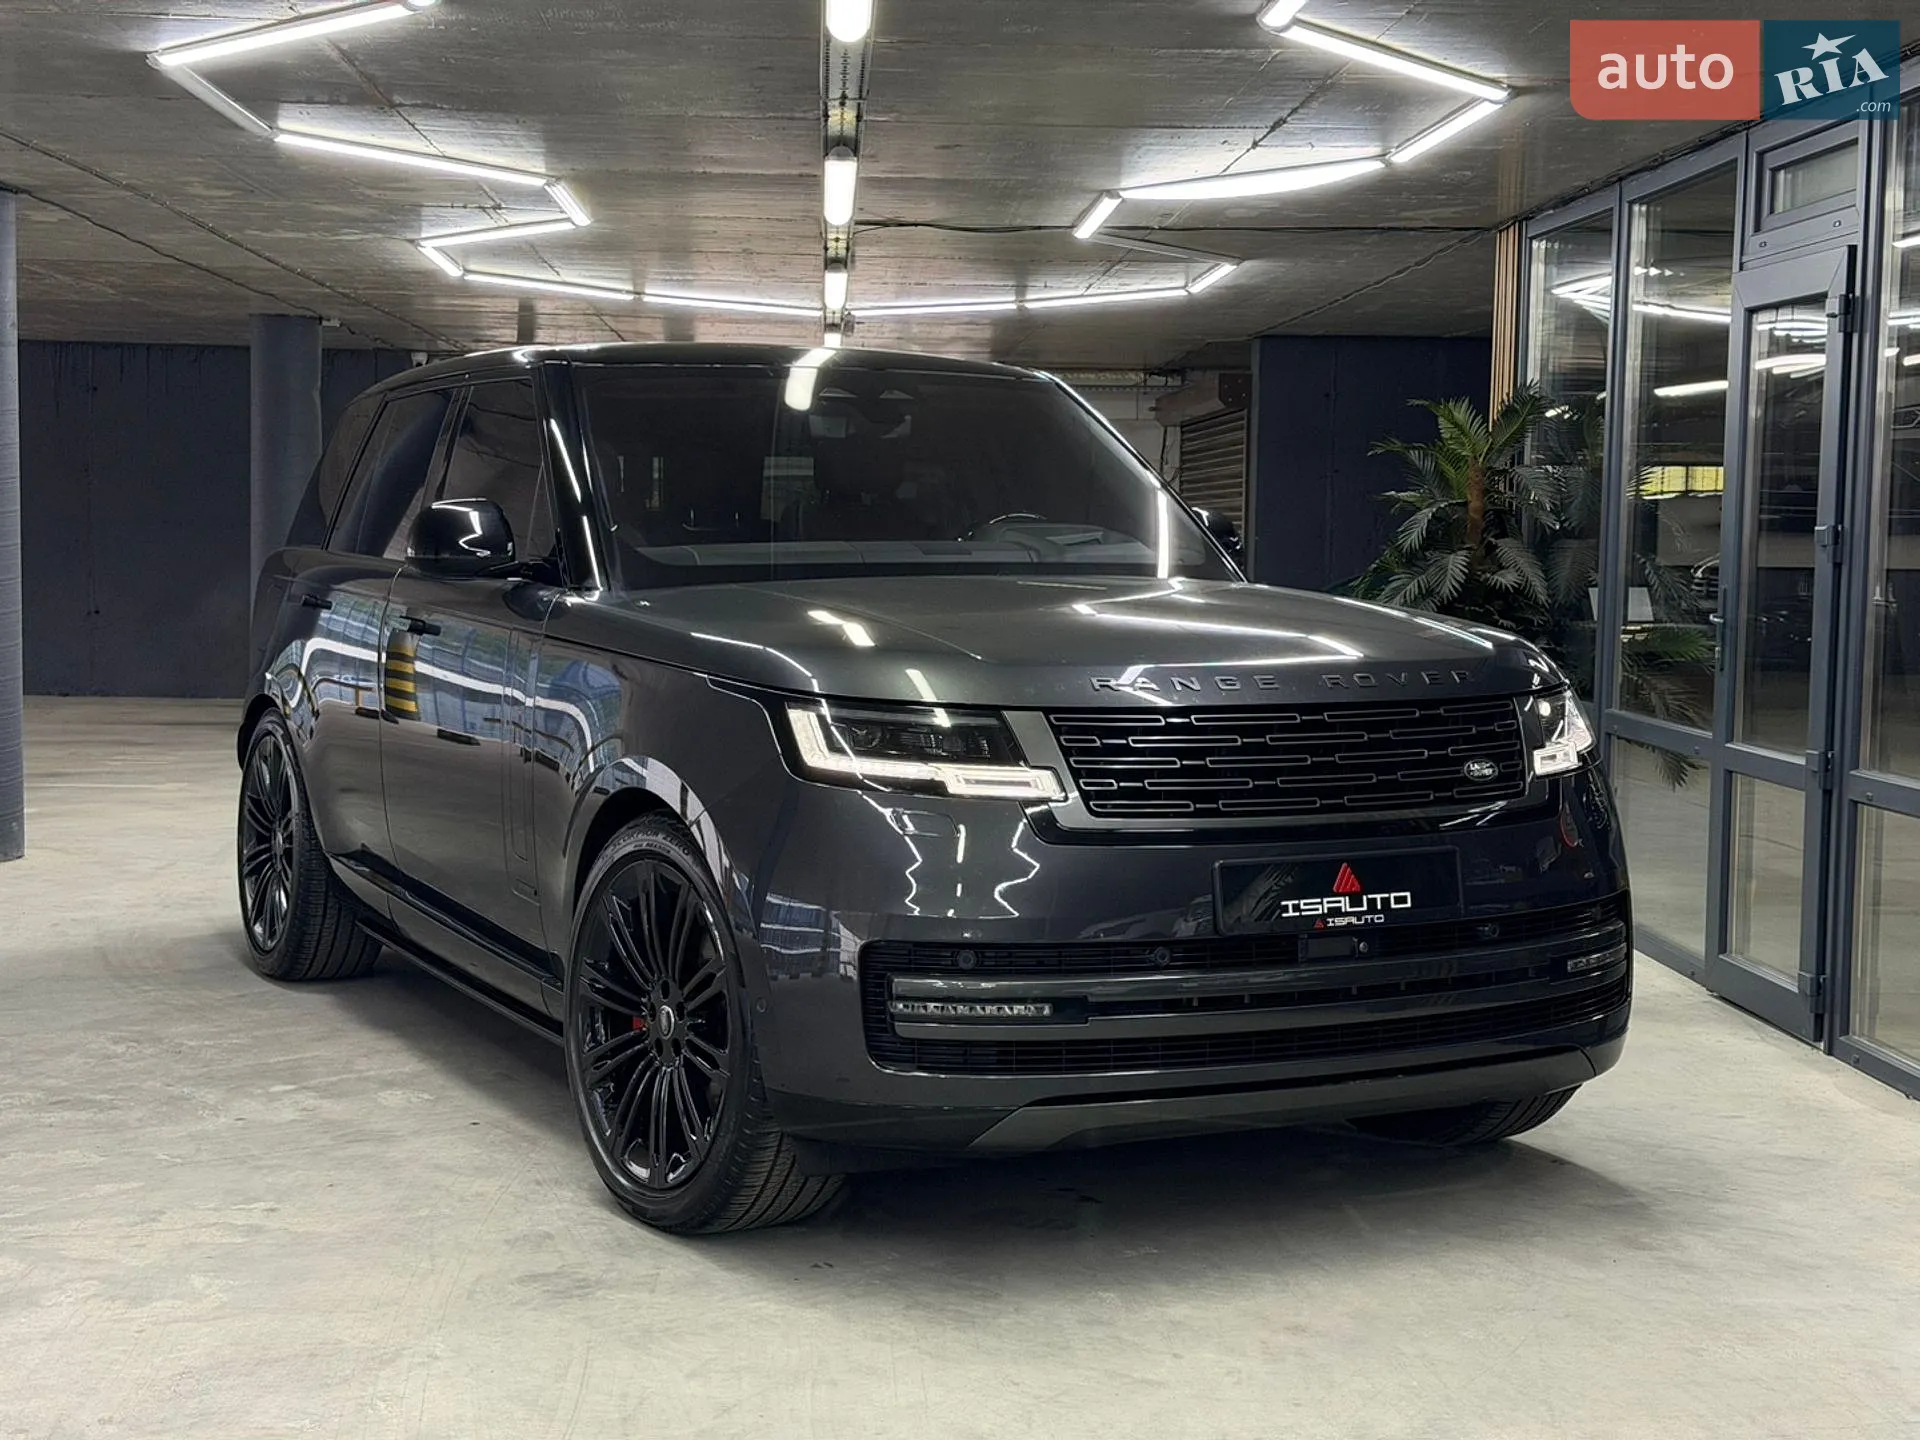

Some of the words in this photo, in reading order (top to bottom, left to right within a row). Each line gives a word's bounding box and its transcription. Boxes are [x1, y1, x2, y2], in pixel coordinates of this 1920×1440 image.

[1089, 674, 1281, 692] RANGE
[1320, 669, 1476, 690] ROVER
[1280, 891, 1412, 918] ISAUTO
[1326, 914, 1385, 928] ISAUTO
